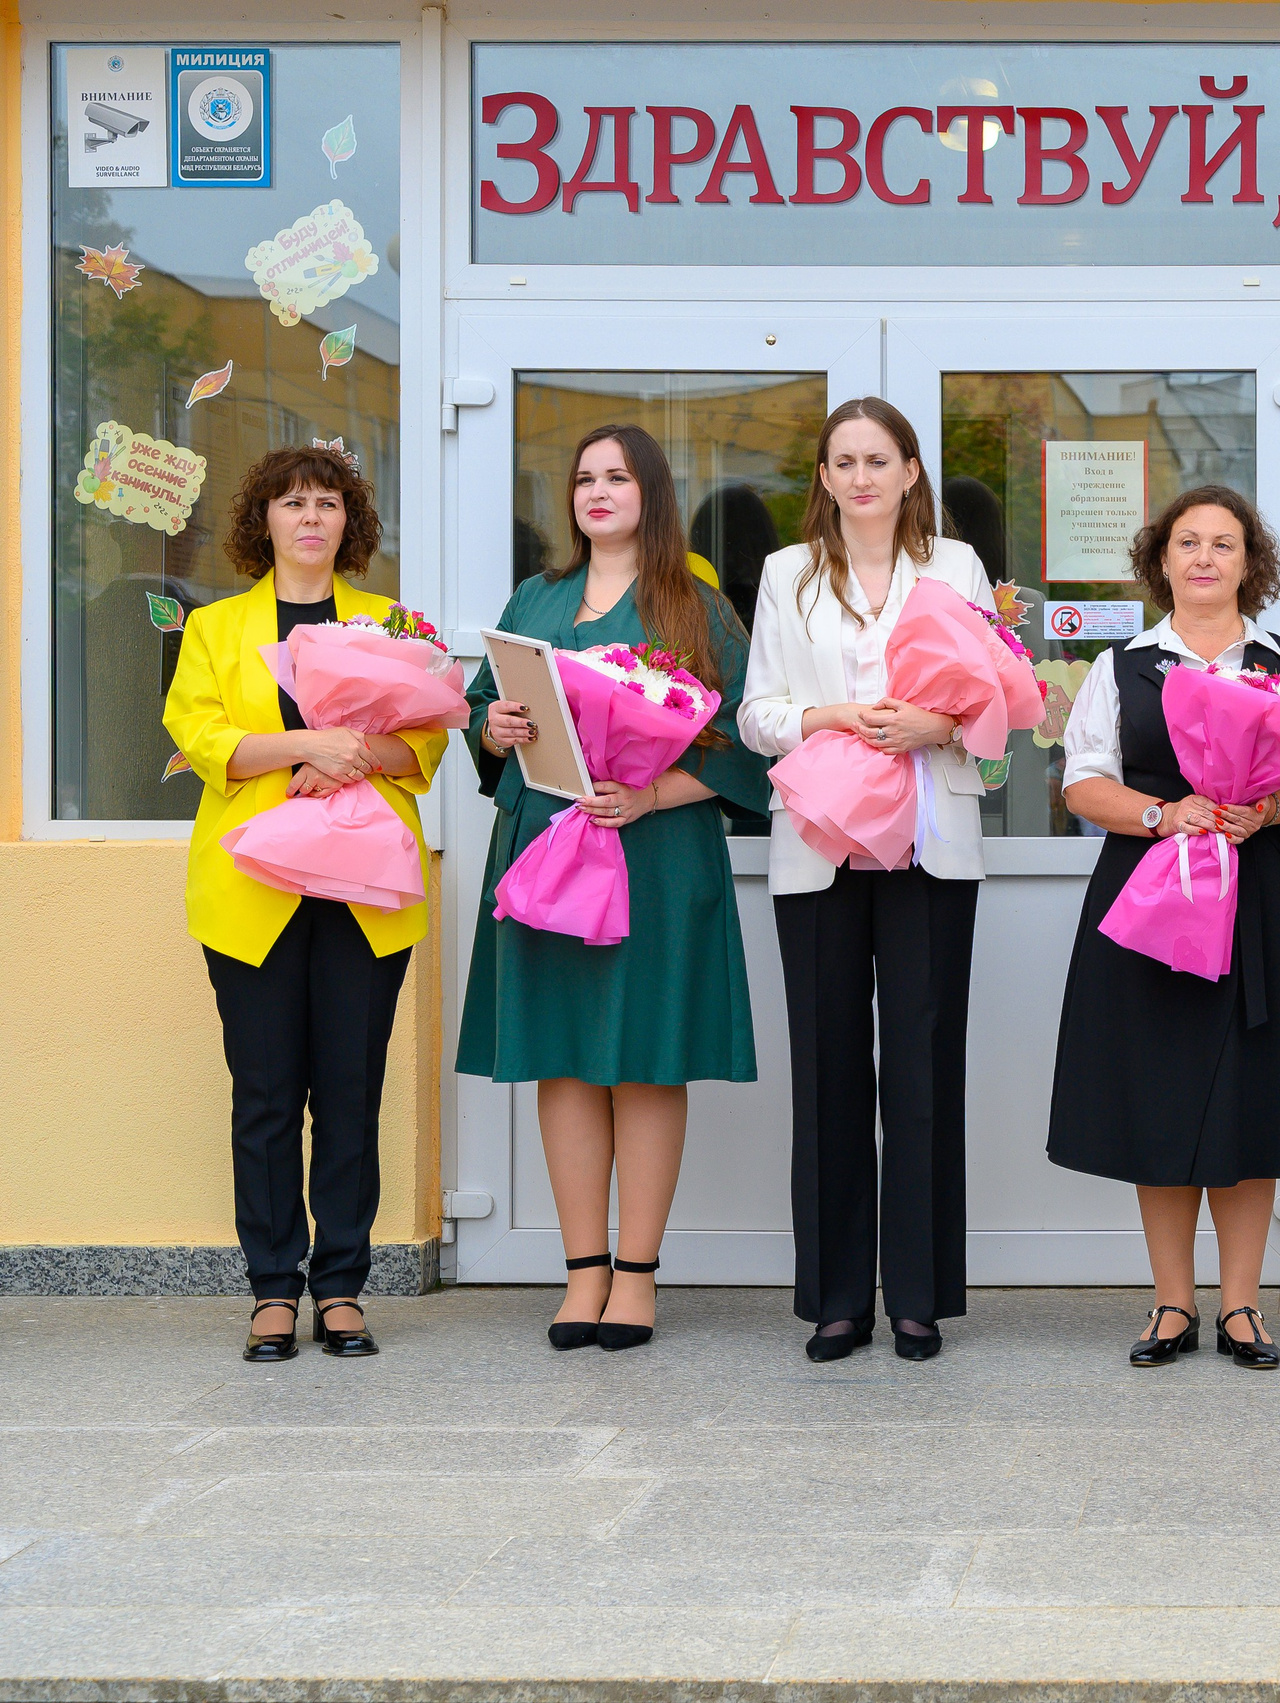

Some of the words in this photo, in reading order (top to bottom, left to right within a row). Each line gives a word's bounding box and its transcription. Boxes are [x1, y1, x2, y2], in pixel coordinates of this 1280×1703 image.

[176, 53, 265, 68] МИЛИЦИЯ
[81, 92, 153, 102] ВНИМАНИЕ
[184, 155, 235, 163] ДЕПАРТАМЕНТОМ
[181, 164, 194, 172] МВД
[277, 221, 319, 251] Буду
[266, 218, 350, 280] отличницей!
[129, 440, 162, 460] уже
[163, 453, 197, 476] жду
[1060, 451, 1136, 461] ВНИМАНИЕ!
[127, 458, 188, 489] осенние
[1084, 467, 1106, 476] Вход
[110, 470, 190, 510] каникулы...
[1071, 482, 1126, 490] учреждение
[1070, 494, 1127, 503] образования
[1060, 508, 1104, 518] разрешен
[1106, 508, 1138, 516] только
[1071, 521, 1119, 530] учащимся
[1120, 521, 1127, 529] и
[1069, 535, 1129, 544] сотрудникам
[1081, 547, 1117, 555] школы.
